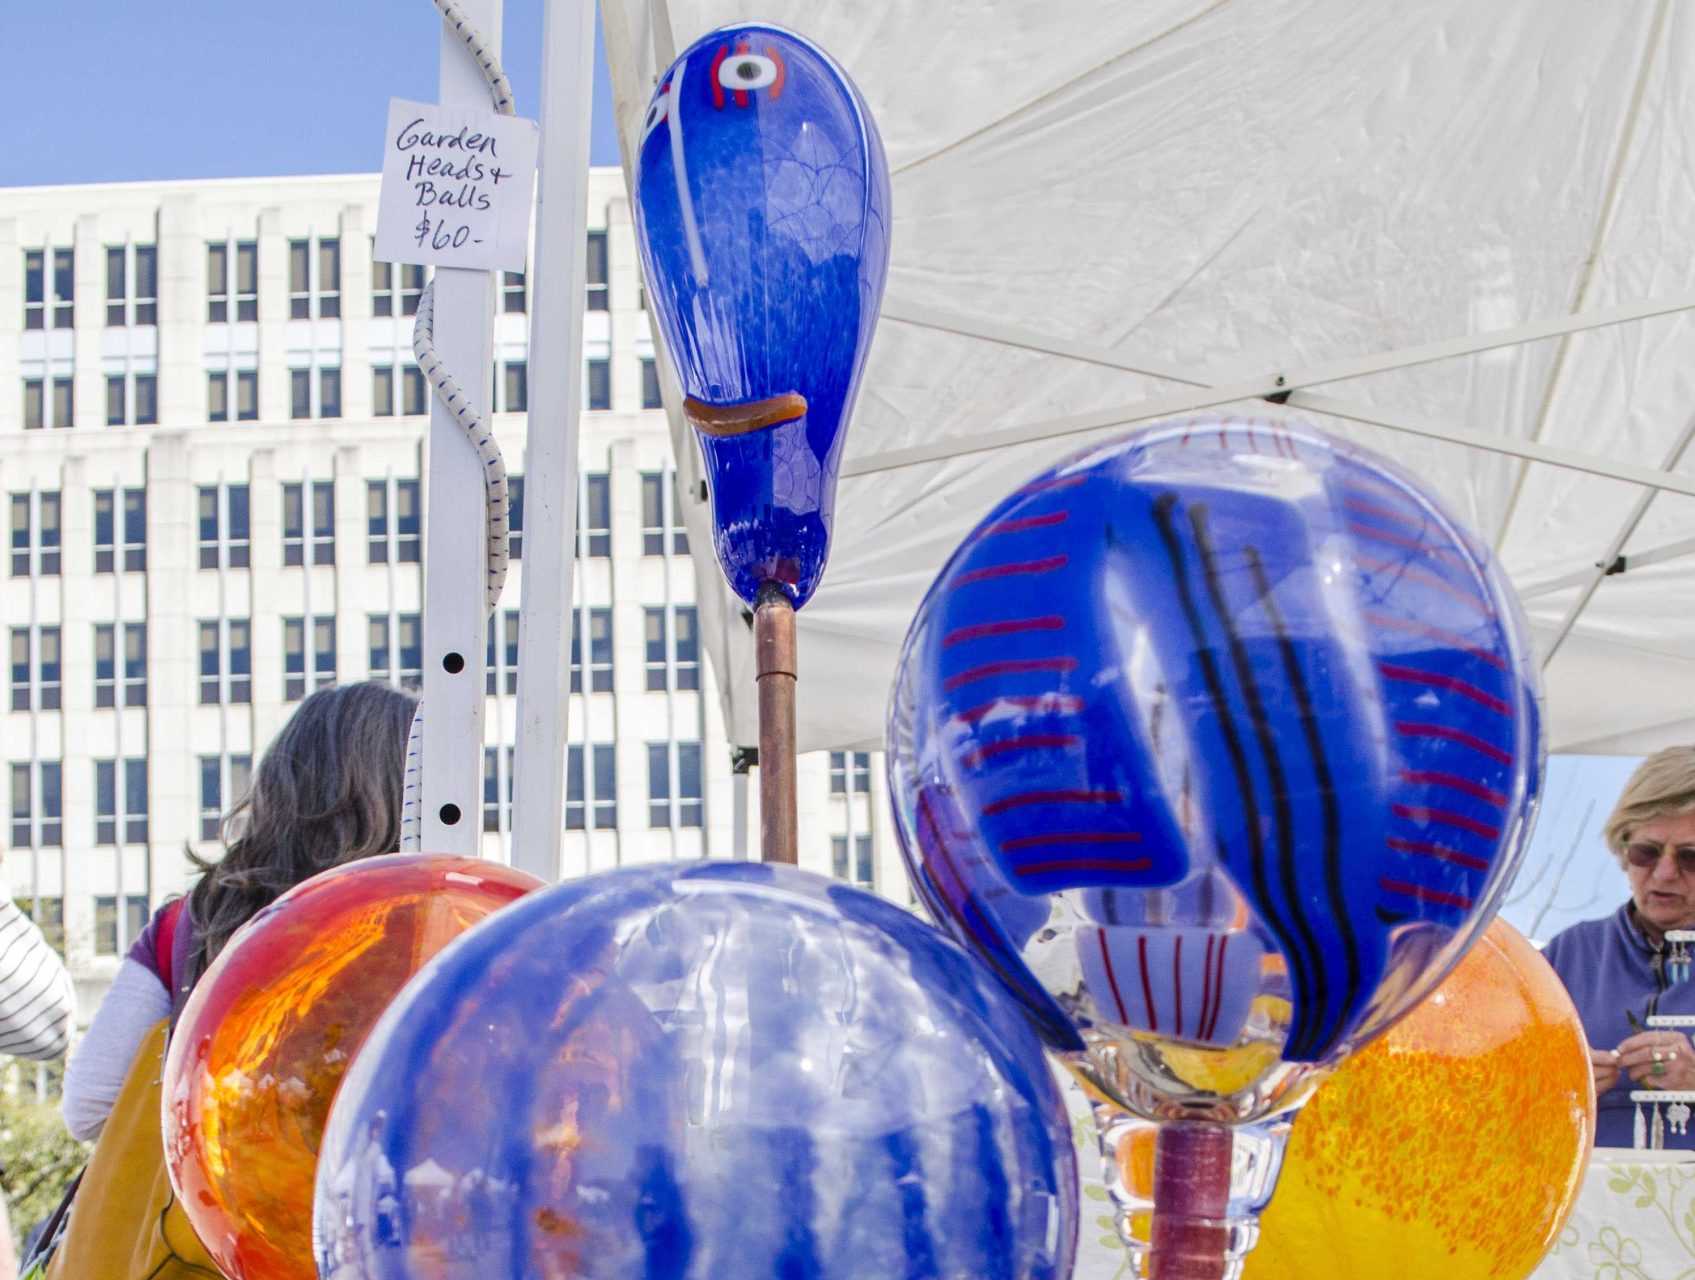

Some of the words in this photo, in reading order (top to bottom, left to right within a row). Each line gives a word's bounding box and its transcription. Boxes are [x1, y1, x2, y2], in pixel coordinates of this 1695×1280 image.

[396, 118, 496, 157] Garden
[406, 154, 484, 181] Heads
[414, 181, 491, 210] Balls
